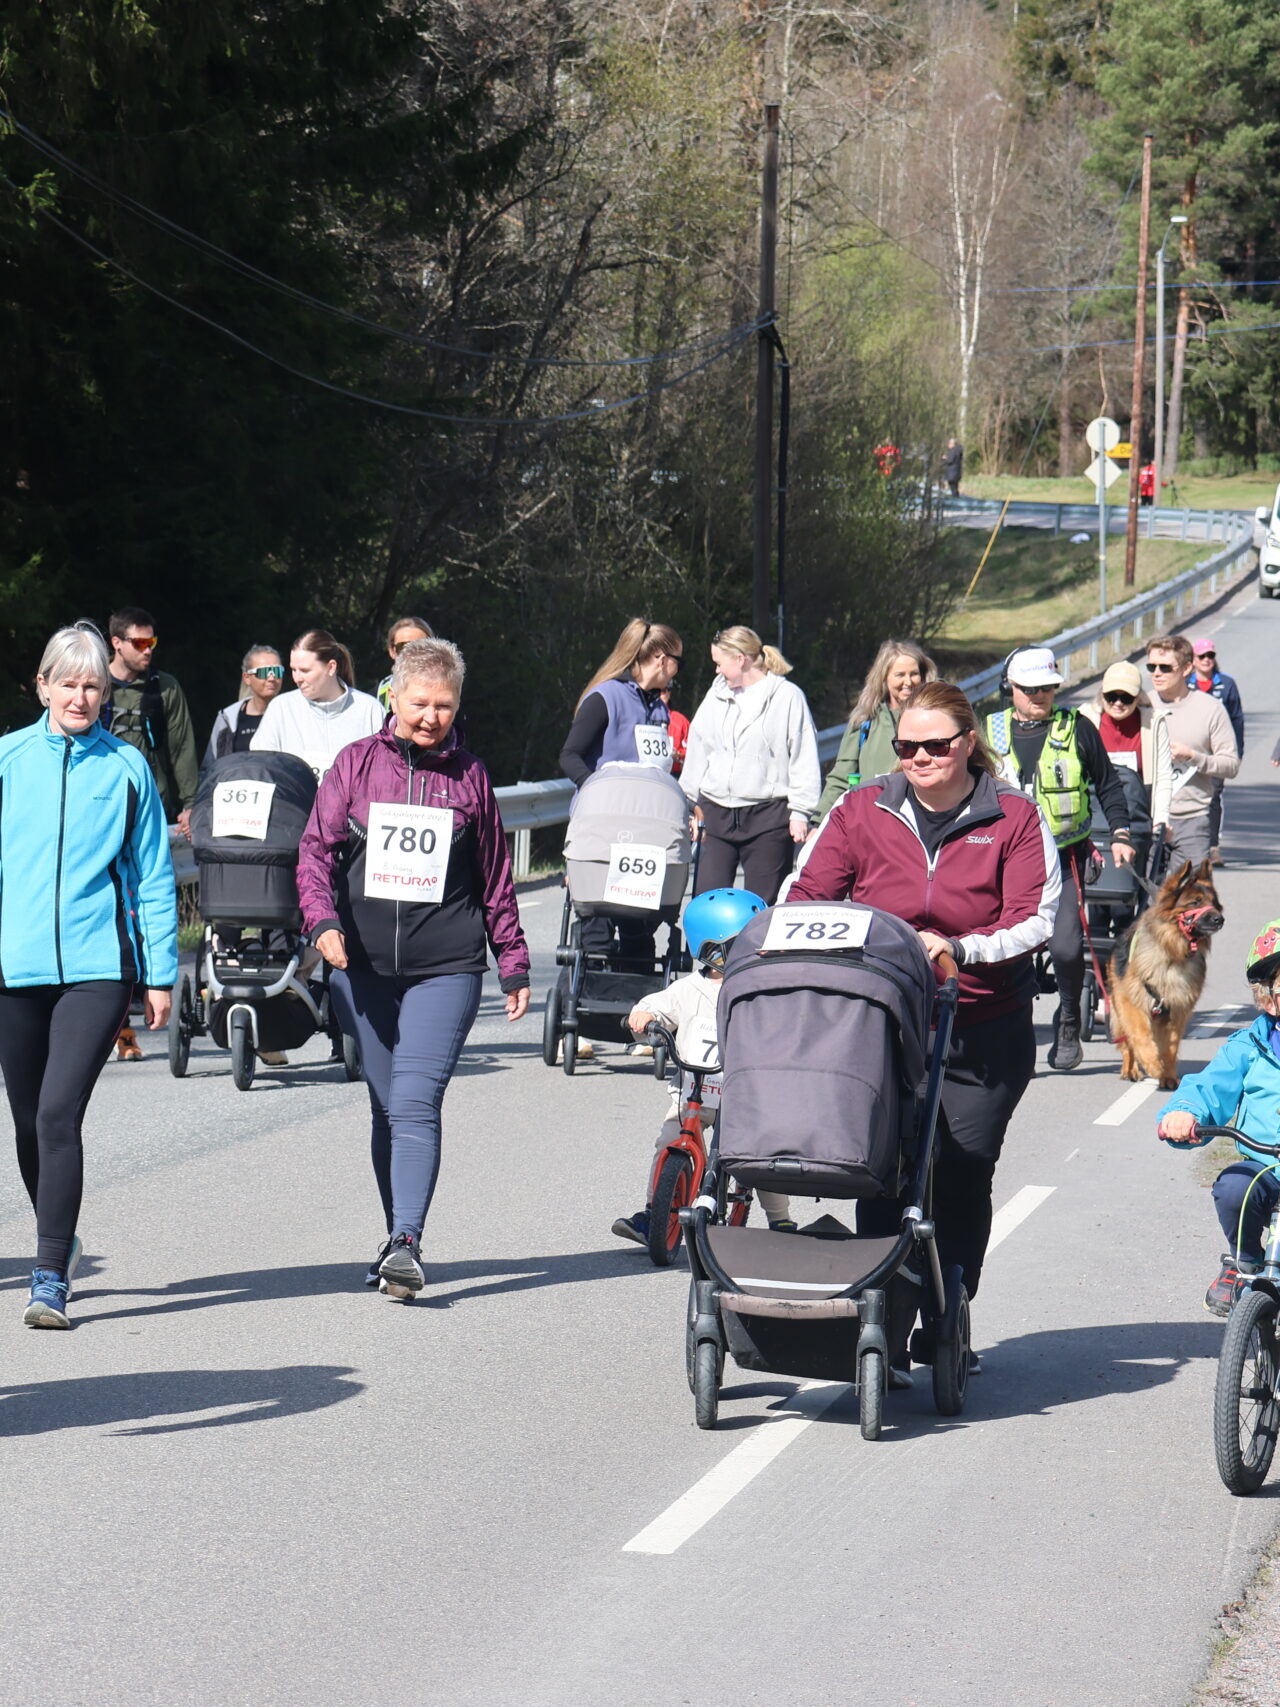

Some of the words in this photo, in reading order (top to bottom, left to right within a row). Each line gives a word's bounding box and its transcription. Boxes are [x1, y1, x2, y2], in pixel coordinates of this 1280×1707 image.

[642, 738, 669, 757] 338
[222, 789, 259, 805] 361
[381, 825, 436, 855] 780
[618, 856, 657, 876] 659
[372, 872, 432, 887] RETURA
[785, 922, 851, 940] 782
